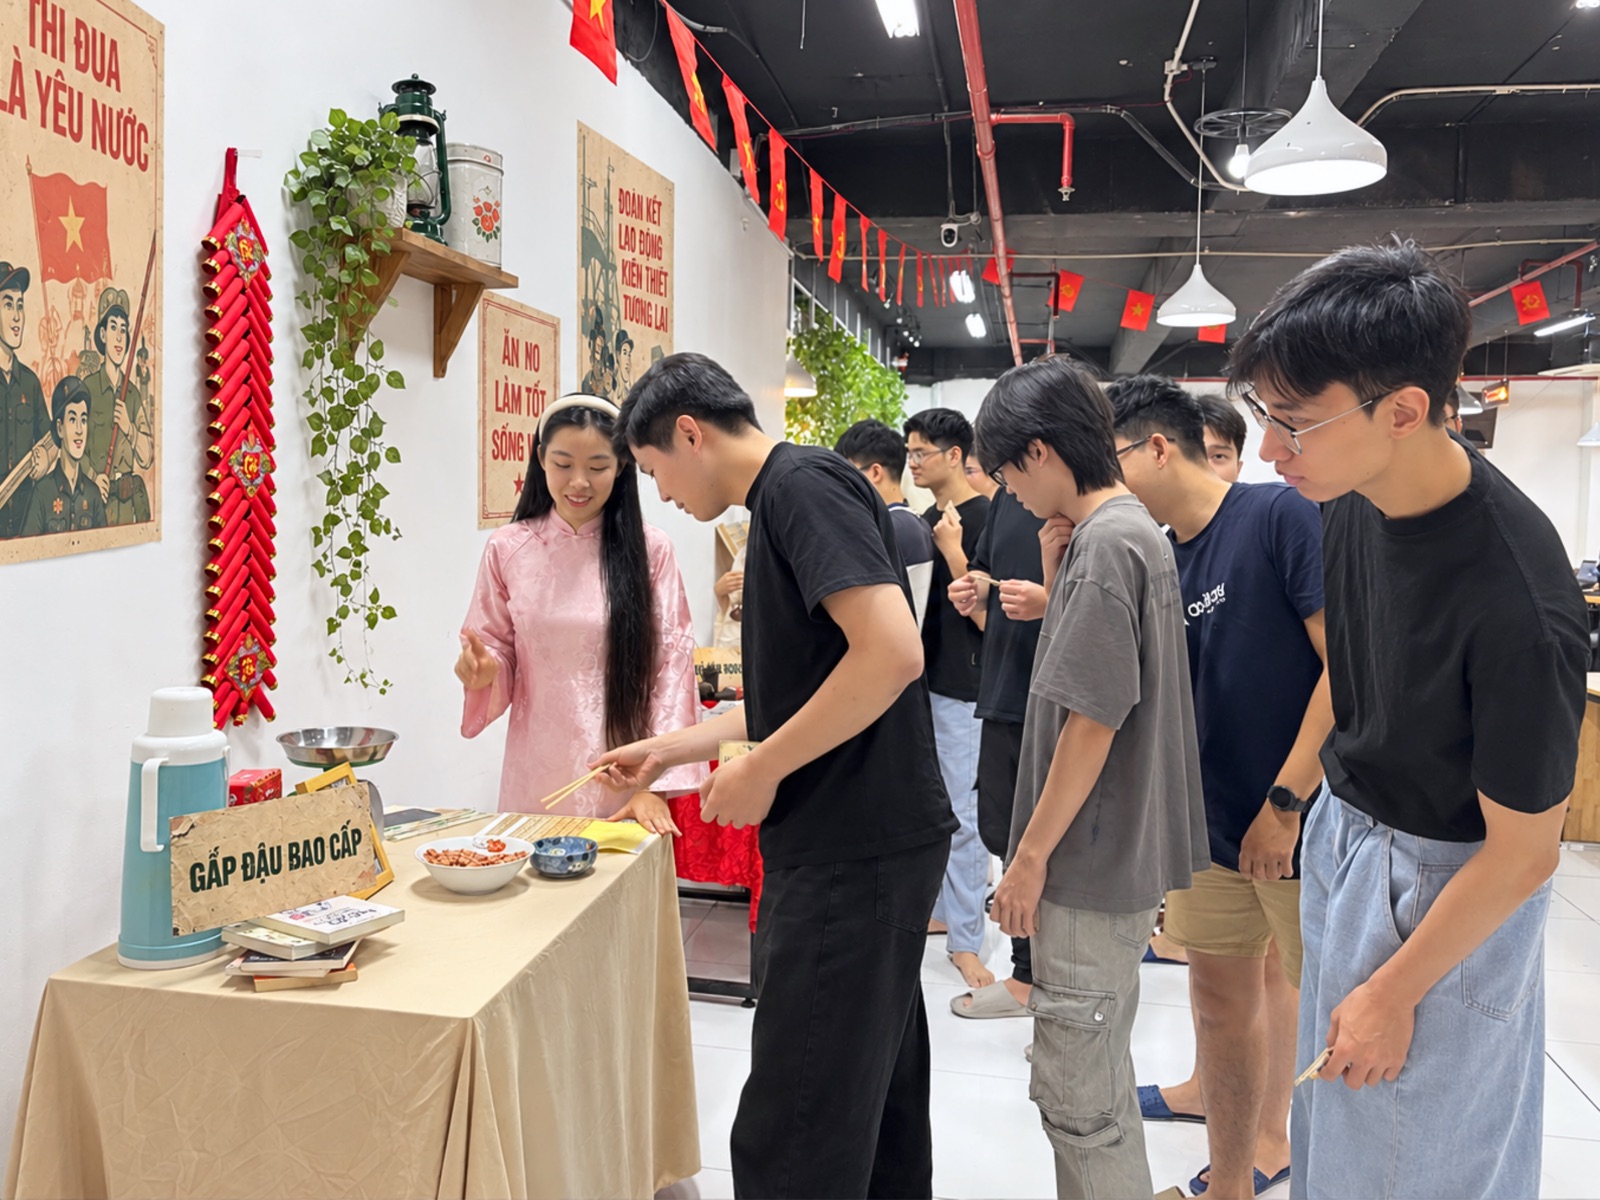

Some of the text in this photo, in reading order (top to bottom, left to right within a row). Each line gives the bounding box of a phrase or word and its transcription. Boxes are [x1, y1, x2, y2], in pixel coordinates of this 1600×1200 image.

[28, 0, 121, 93] THI ĐUA
[0, 44, 149, 172] À YÊU NƯỚC
[619, 223, 636, 253] LAO
[654, 303, 669, 333] LAI
[502, 328, 540, 373] ĂN NO
[494, 374, 547, 418] LÀM TỐT
[491, 421, 525, 462] SỐNG
[240, 842, 282, 884] ĐẬU
[288, 836, 326, 872] BAO
[329, 819, 363, 861] CẤP
